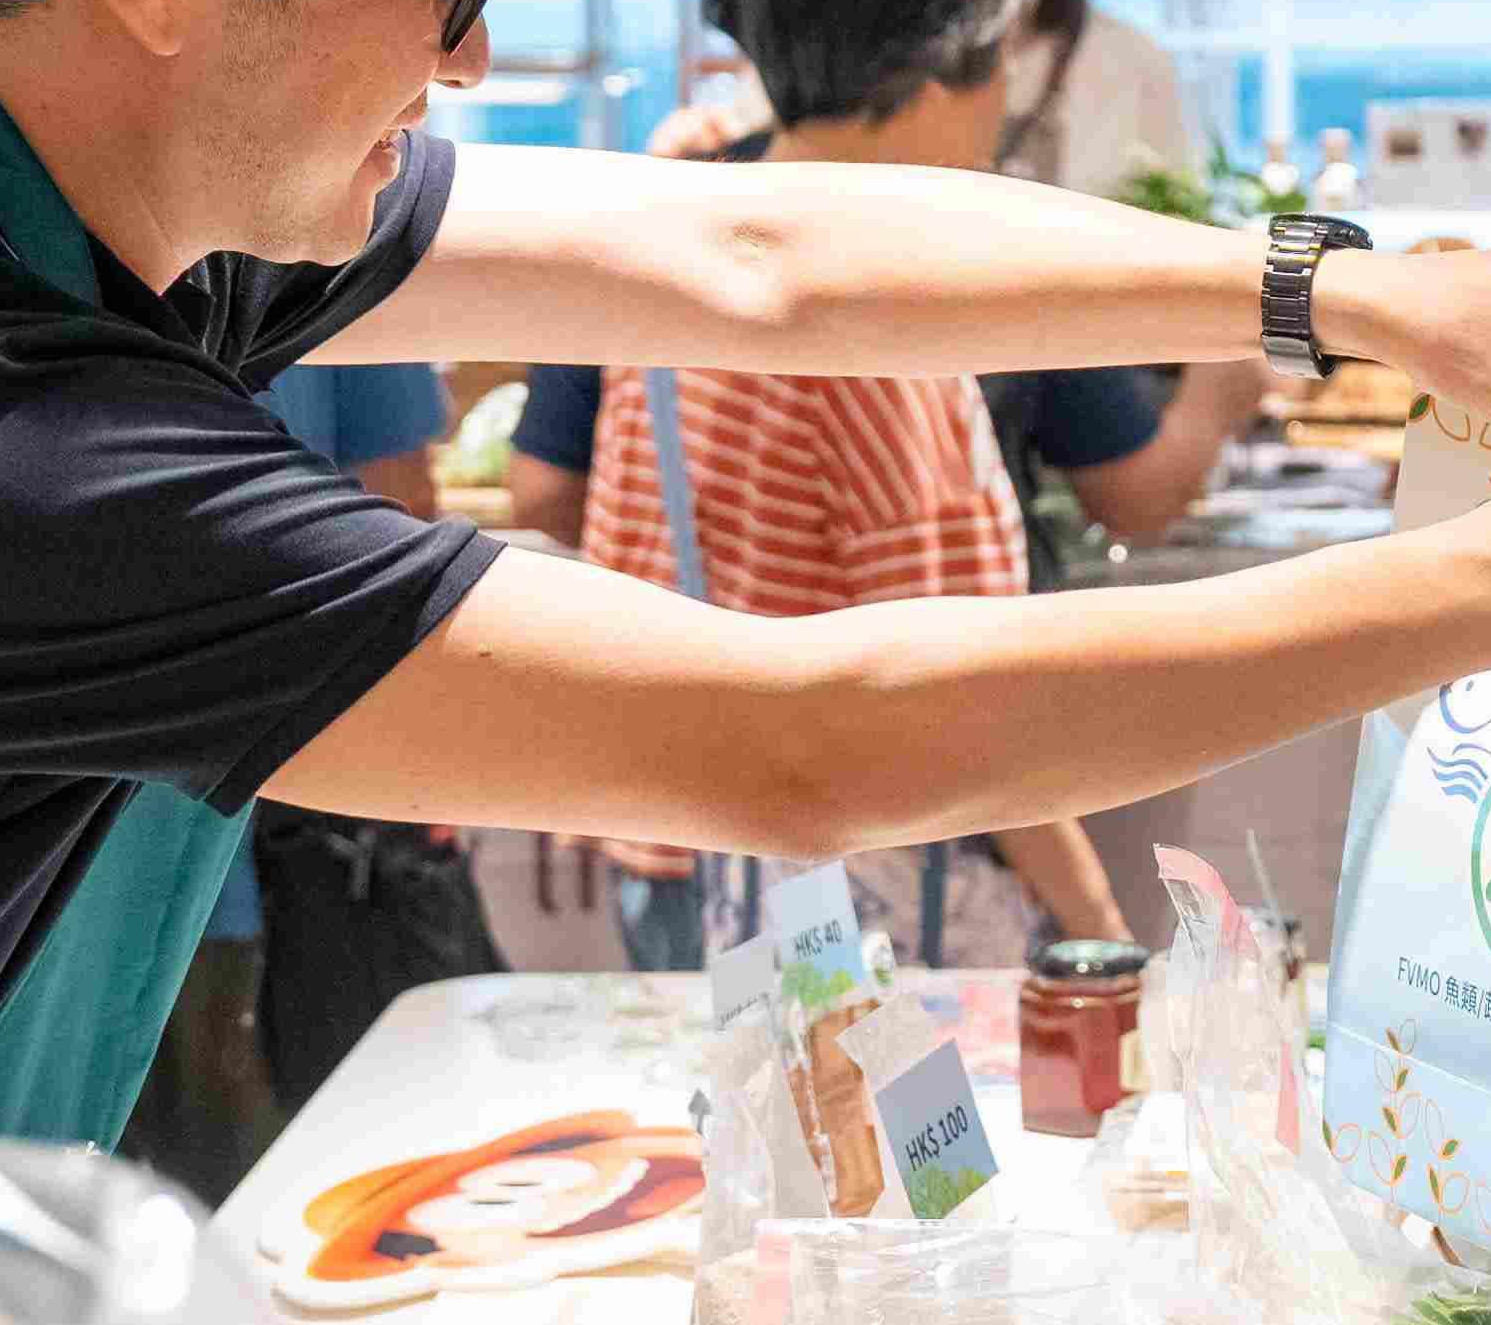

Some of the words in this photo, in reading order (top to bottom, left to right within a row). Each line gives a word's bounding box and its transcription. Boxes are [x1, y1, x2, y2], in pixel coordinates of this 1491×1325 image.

[1397, 956, 1441, 996] FVMO
[905, 1122, 941, 1171] HK$
[938, 1105, 968, 1147] 100
